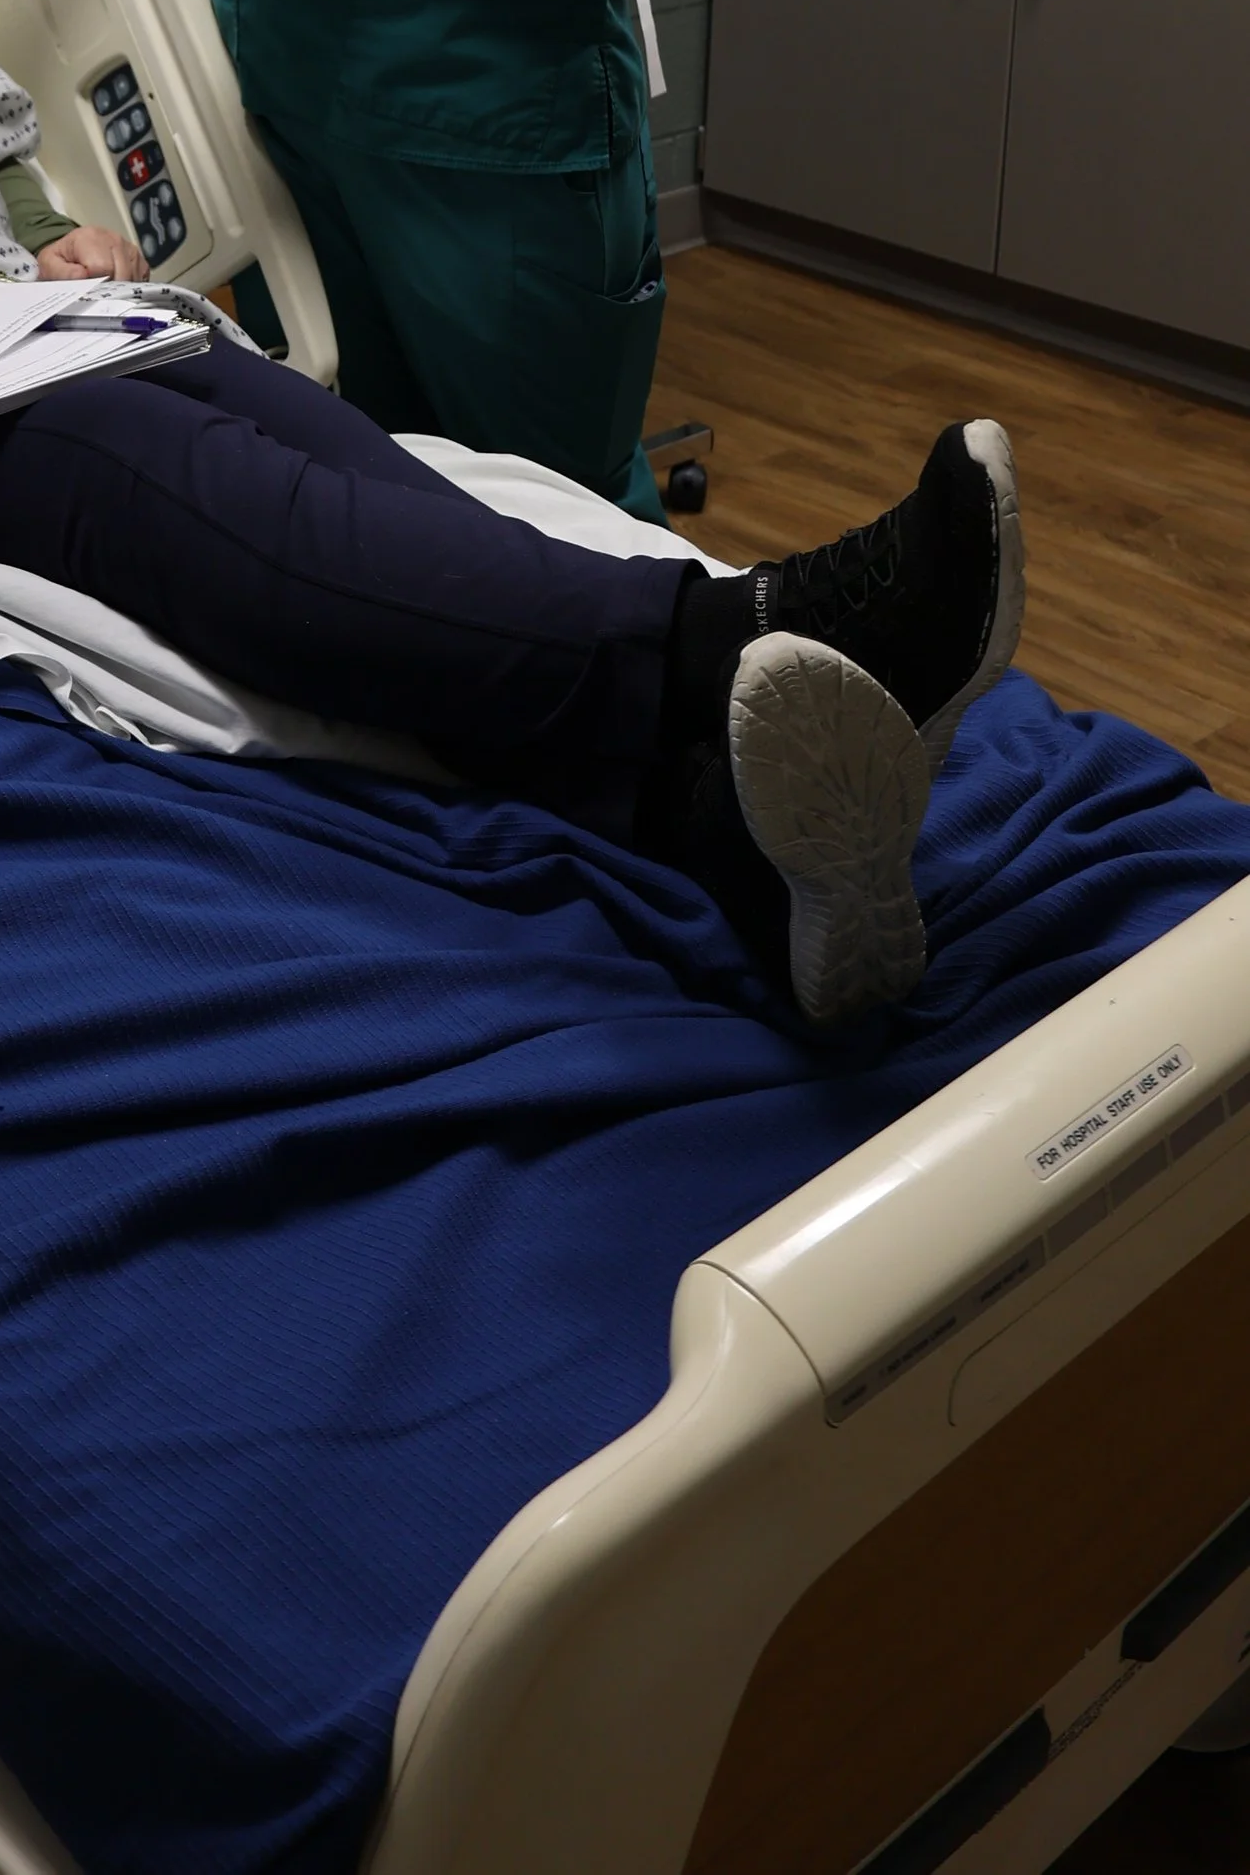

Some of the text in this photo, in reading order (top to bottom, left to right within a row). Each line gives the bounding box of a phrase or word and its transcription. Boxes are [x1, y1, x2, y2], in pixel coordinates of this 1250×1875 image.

[755, 576, 769, 633] SKECHERS
[1036, 1054, 1183, 1170] FOR HOSPITAL STAFF USE ONLY
